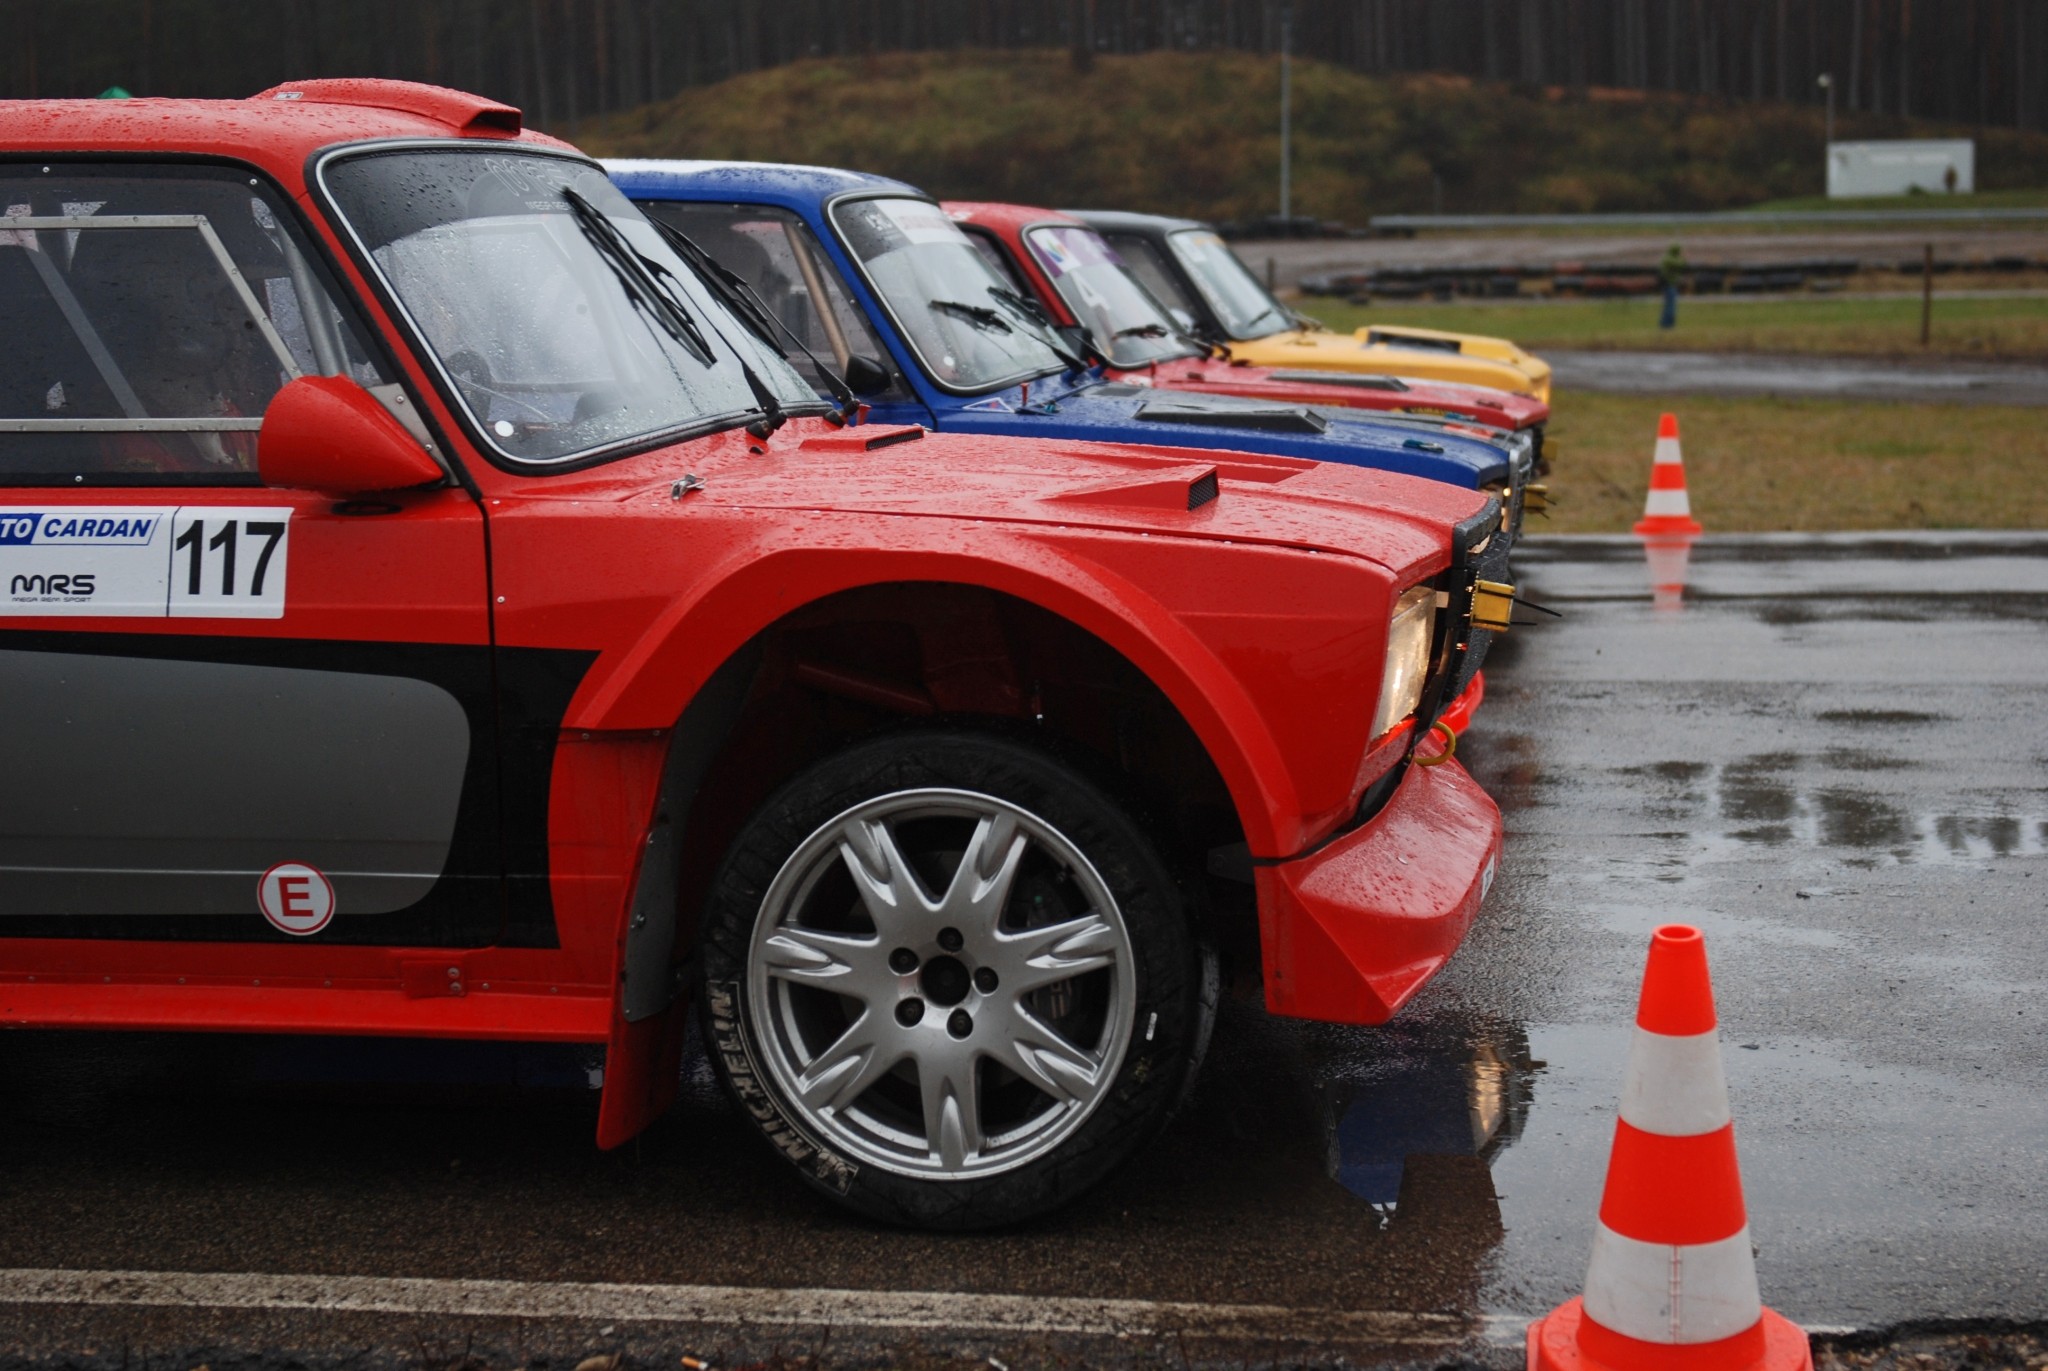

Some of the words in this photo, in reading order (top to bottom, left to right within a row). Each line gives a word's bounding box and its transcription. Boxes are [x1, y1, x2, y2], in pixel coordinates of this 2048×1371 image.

[44, 518, 152, 538] CARDAN
[176, 519, 285, 596] 117
[10, 574, 95, 595] MRS
[278, 877, 315, 917] E
[706, 982, 813, 1161] MICHELIN
